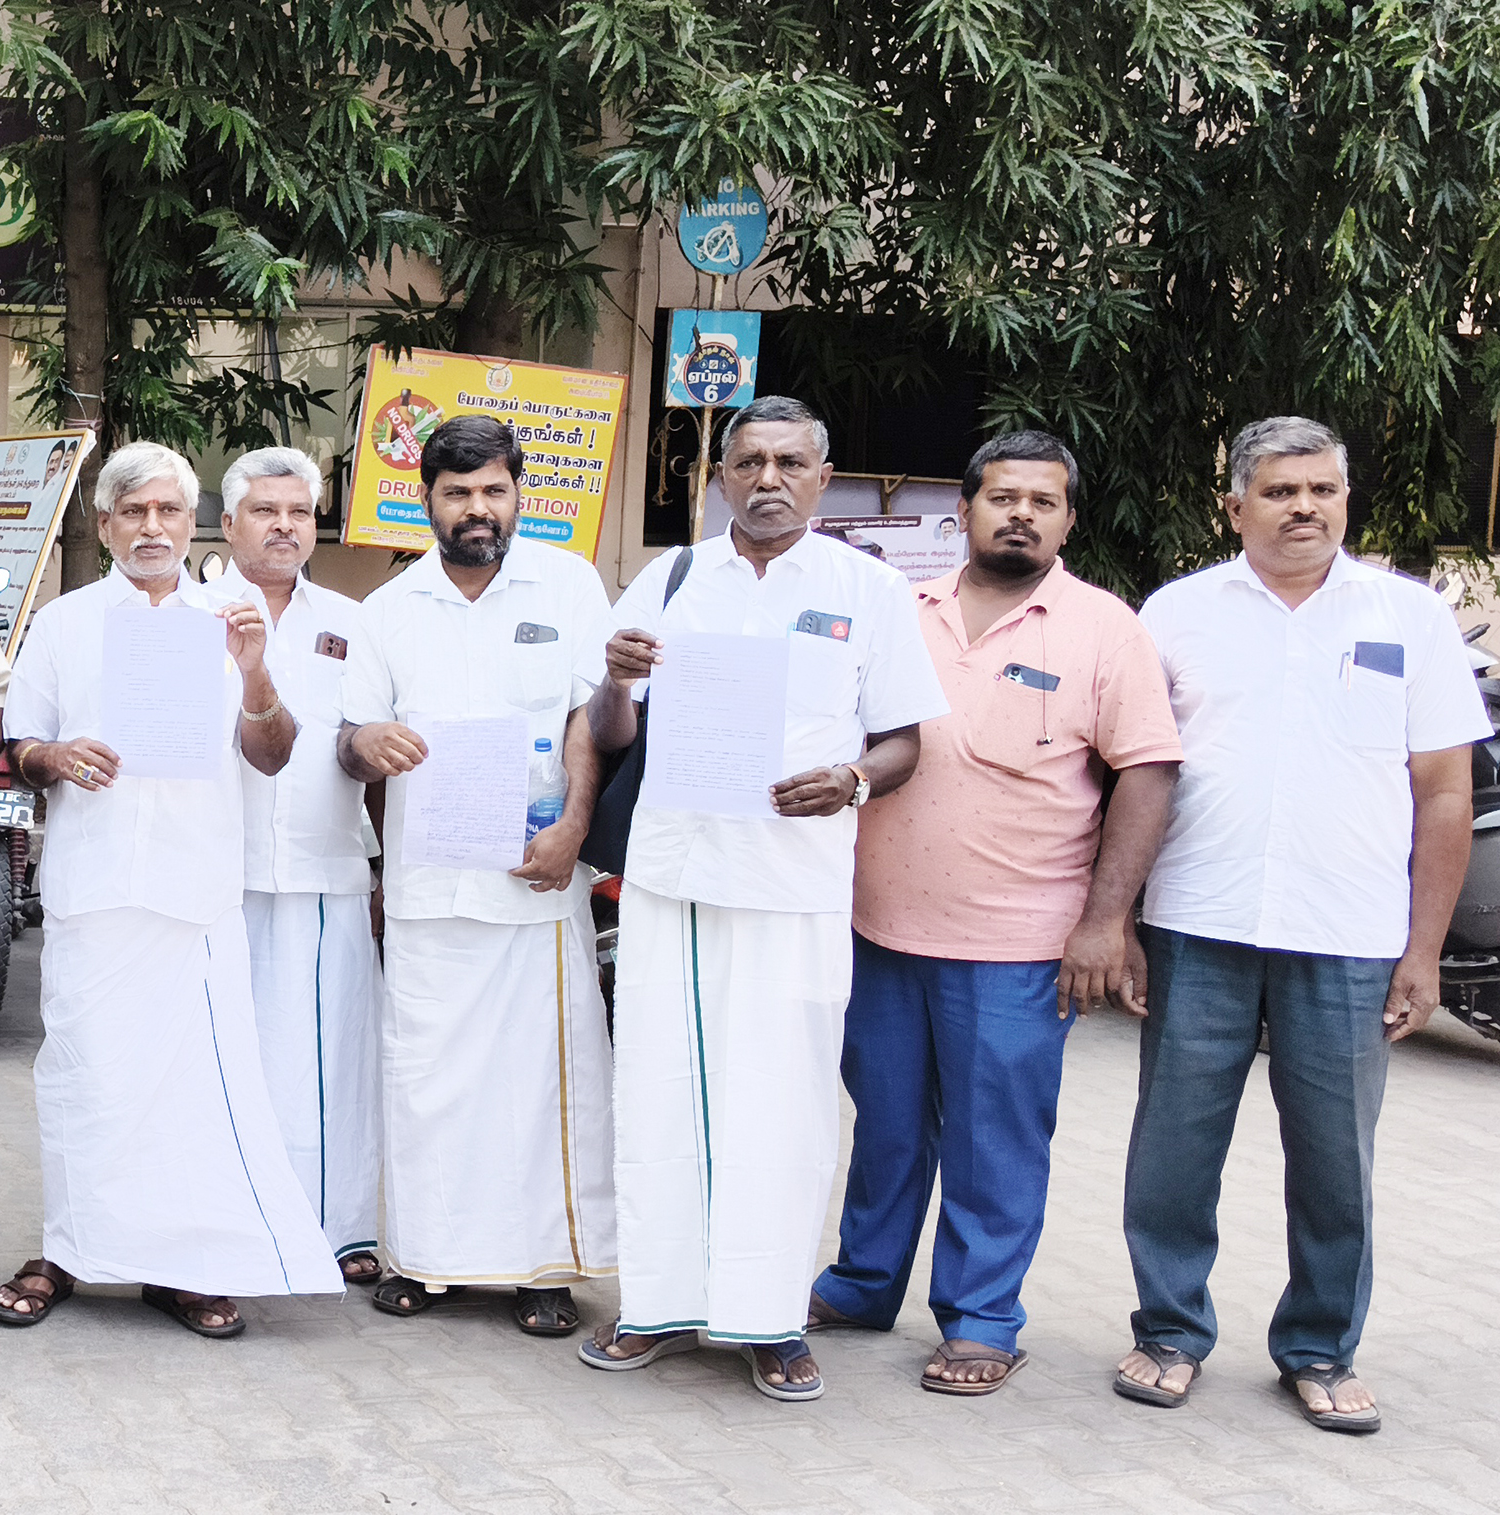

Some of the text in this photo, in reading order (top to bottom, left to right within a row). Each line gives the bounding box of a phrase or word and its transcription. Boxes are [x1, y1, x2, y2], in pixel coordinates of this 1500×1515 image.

[687, 369, 737, 385] ஏப்ரல்
[703, 384, 719, 403] 6
[387, 407, 402, 425] NO
[457, 391, 612, 423] போதைப் பொருட்களை
